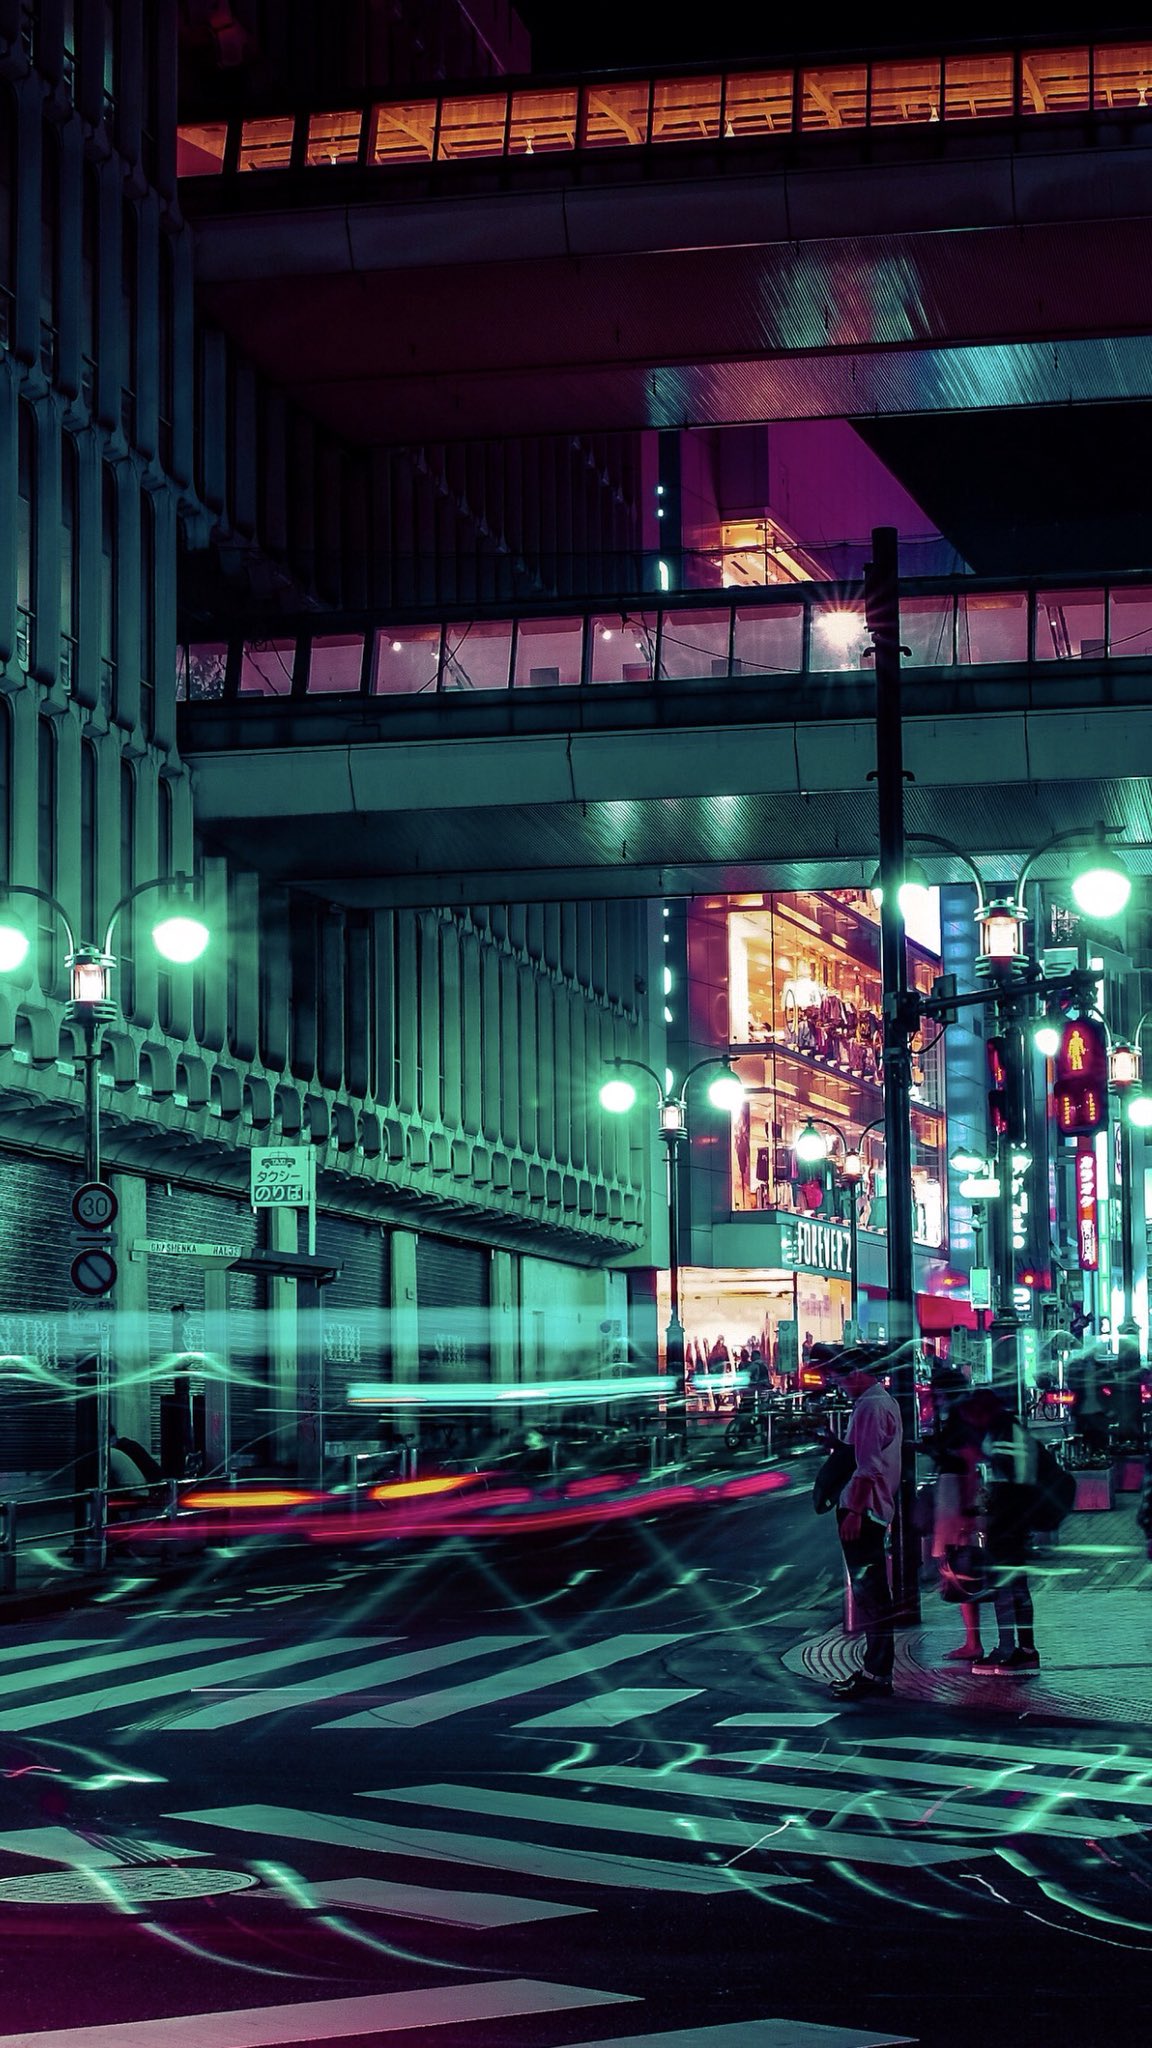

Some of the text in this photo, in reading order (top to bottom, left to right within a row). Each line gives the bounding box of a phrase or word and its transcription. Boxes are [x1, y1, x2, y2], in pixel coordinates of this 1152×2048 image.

[257, 1170, 301, 1183] タクシー
[255, 1186, 302, 1200] のりば
[82, 1197, 108, 1217] 30
[795, 1221, 843, 1271] FOREVER
